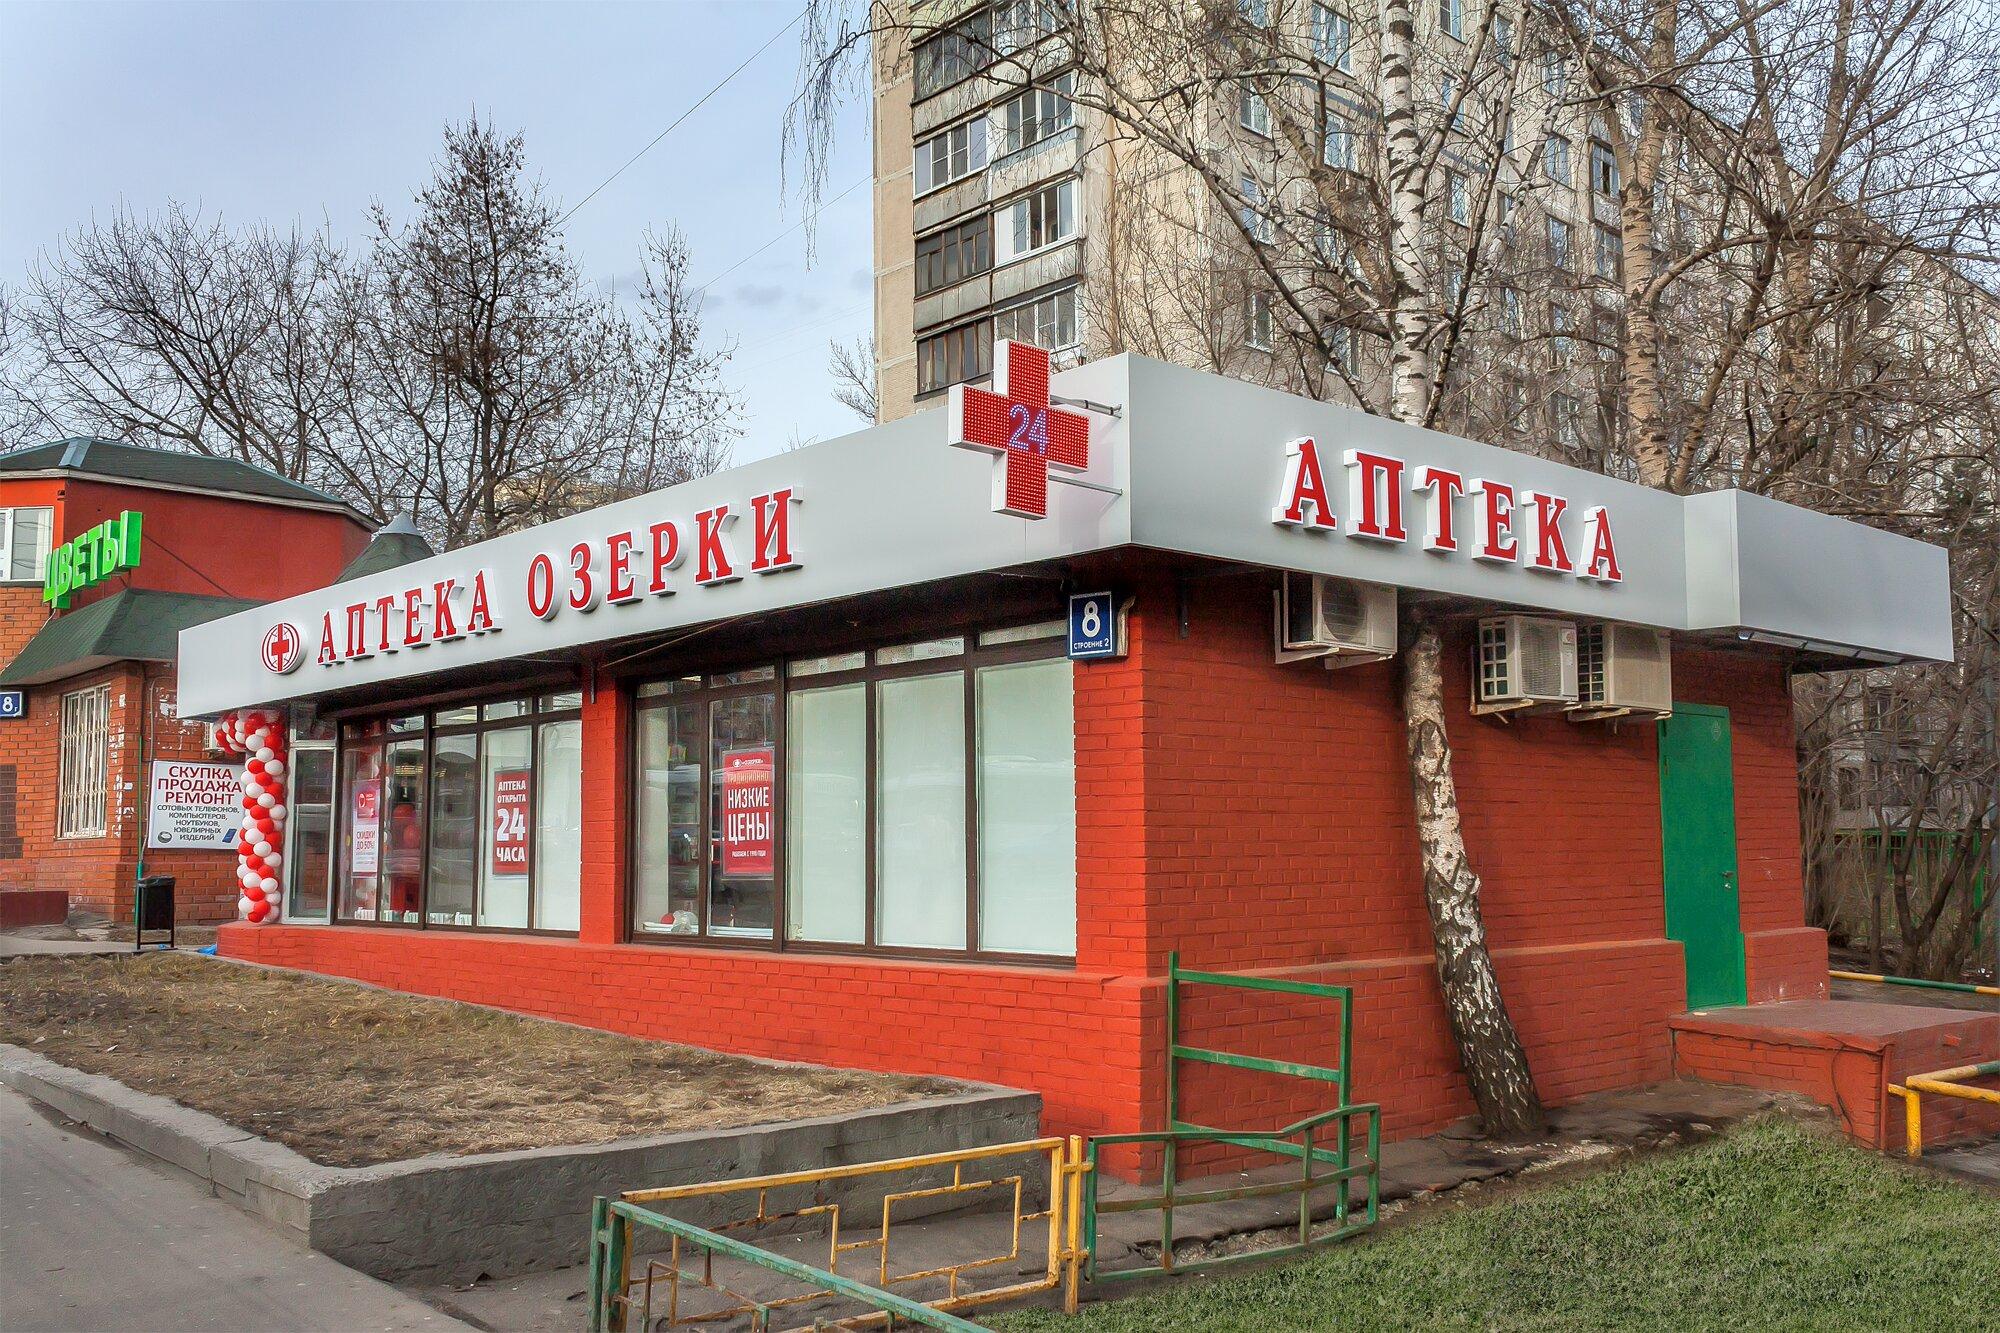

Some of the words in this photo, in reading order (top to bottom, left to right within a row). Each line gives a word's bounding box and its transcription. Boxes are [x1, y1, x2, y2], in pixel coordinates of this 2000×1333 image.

[1009, 404, 1048, 454] 24
[1272, 435, 1624, 583] АПТЕКА
[43, 510, 142, 608] ЦВЕТЫ
[317, 567, 501, 666] АПТЕКА
[525, 485, 803, 622] ОЗЕРКИ
[1082, 600, 1100, 638] 8
[1073, 640, 1103, 649] СТРОЕНИЕ
[1104, 637, 1110, 647] 2
[168, 765, 233, 780] СКУПКА
[158, 778, 242, 793] ПРОДАЖА
[497, 780, 526, 792] АПТЕКА
[165, 791, 235, 805] РЕМОНТ
[497, 794, 526, 803] ОТКРЫТА
[727, 786, 770, 809] НИЗКИЕ
[157, 804, 193, 812] СОТОВЫХ
[195, 805, 240, 814] ТЕЛЕФОНОВ,
[168, 812, 228, 820] КОМПЬЮТЕРОВ,
[173, 826, 222, 834] ЮВЕЛИРНЫХ
[175, 819, 221, 827] НОУТБУКОВ,
[496, 807, 526, 841] 24
[728, 812, 770, 845] ЦЕНЫ
[179, 833, 215, 841] ИЗДЕЛИЙ
[496, 847, 526, 862] ЧАСА
